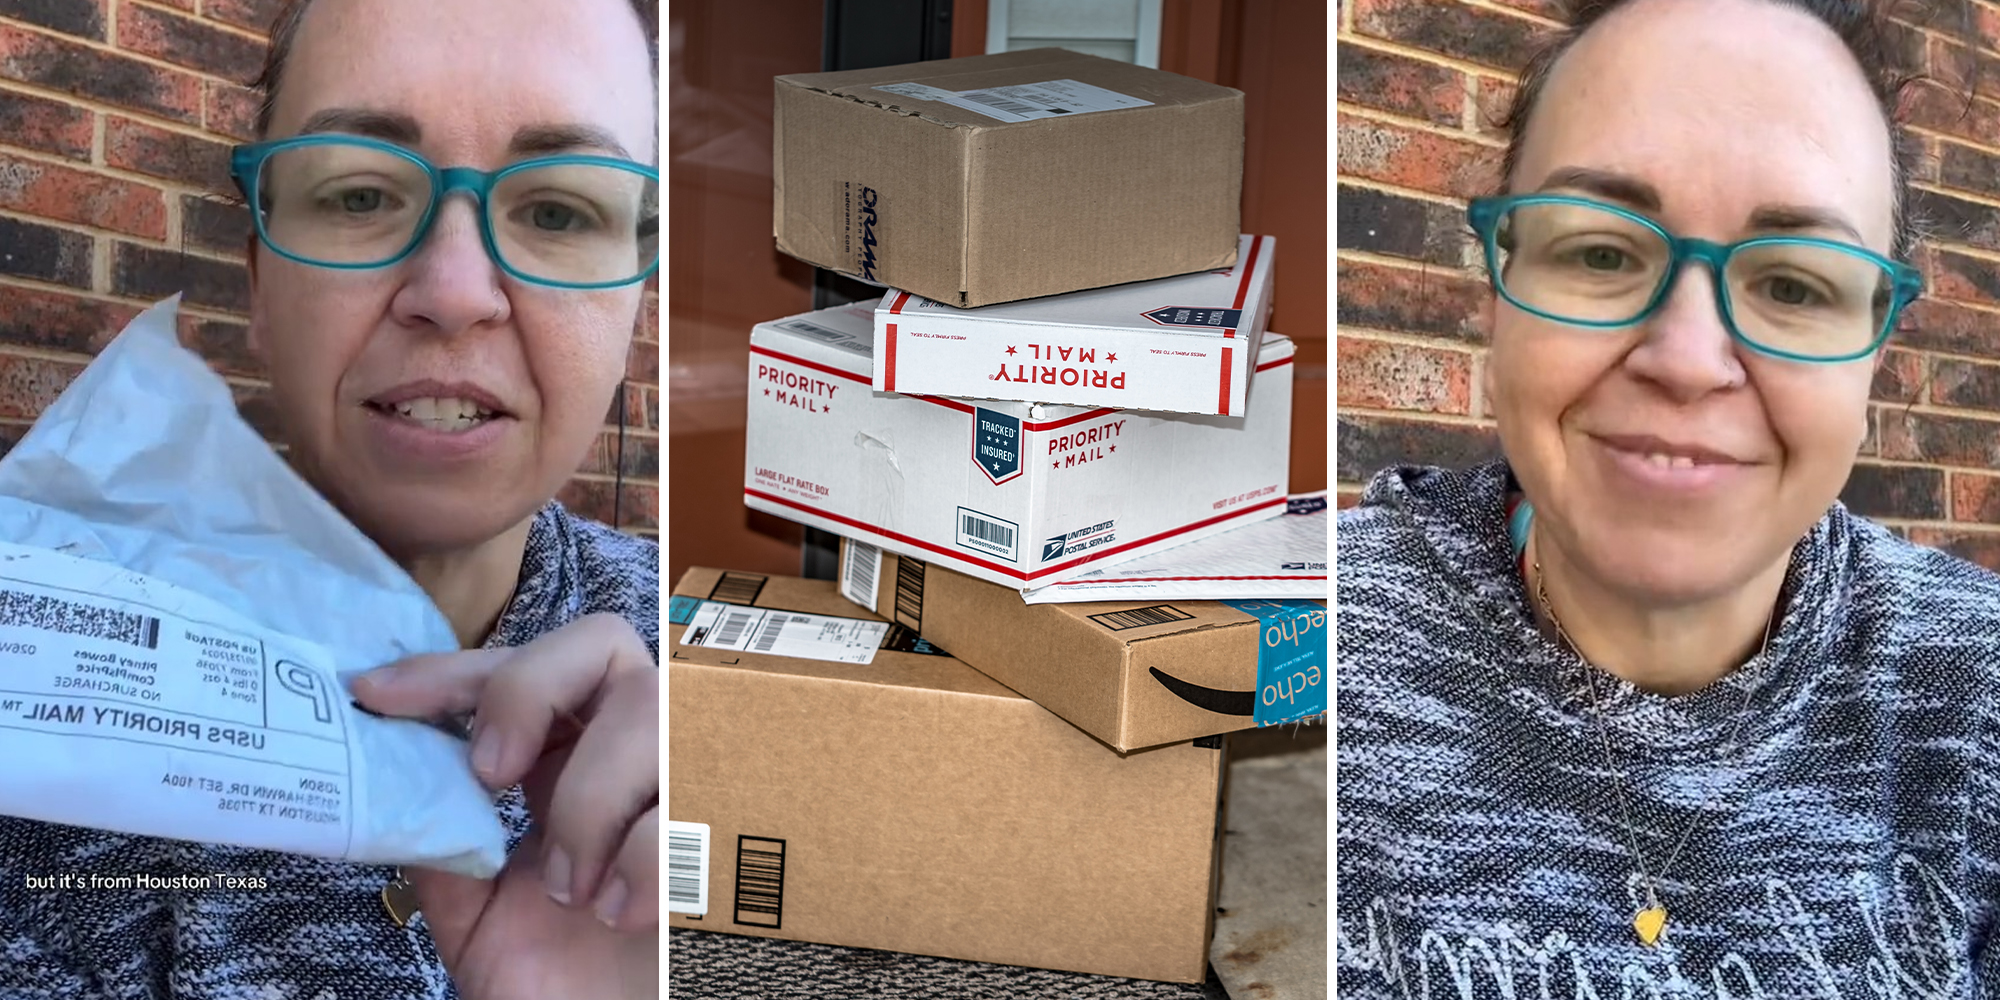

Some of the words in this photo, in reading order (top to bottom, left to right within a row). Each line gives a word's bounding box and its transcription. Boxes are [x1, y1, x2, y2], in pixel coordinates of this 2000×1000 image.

[1028, 343, 1095, 363] MAIL
[776, 389, 817, 413] MAIL
[1065, 446, 1104, 469] MAIL
[754, 466, 777, 481] LARGE
[778, 473, 795, 486] FLAT
[796, 479, 814, 492] RATE
[815, 484, 830, 496] BOX
[755, 477, 766, 486] ONE
[767, 481, 780, 490] RATE
[1228, 495, 1236, 506] US
[1067, 526, 1092, 541] UNITED
[1091, 519, 1114, 534] STATES
[1063, 542, 1088, 556] POSTAL
[1262, 665, 1321, 706] echo
